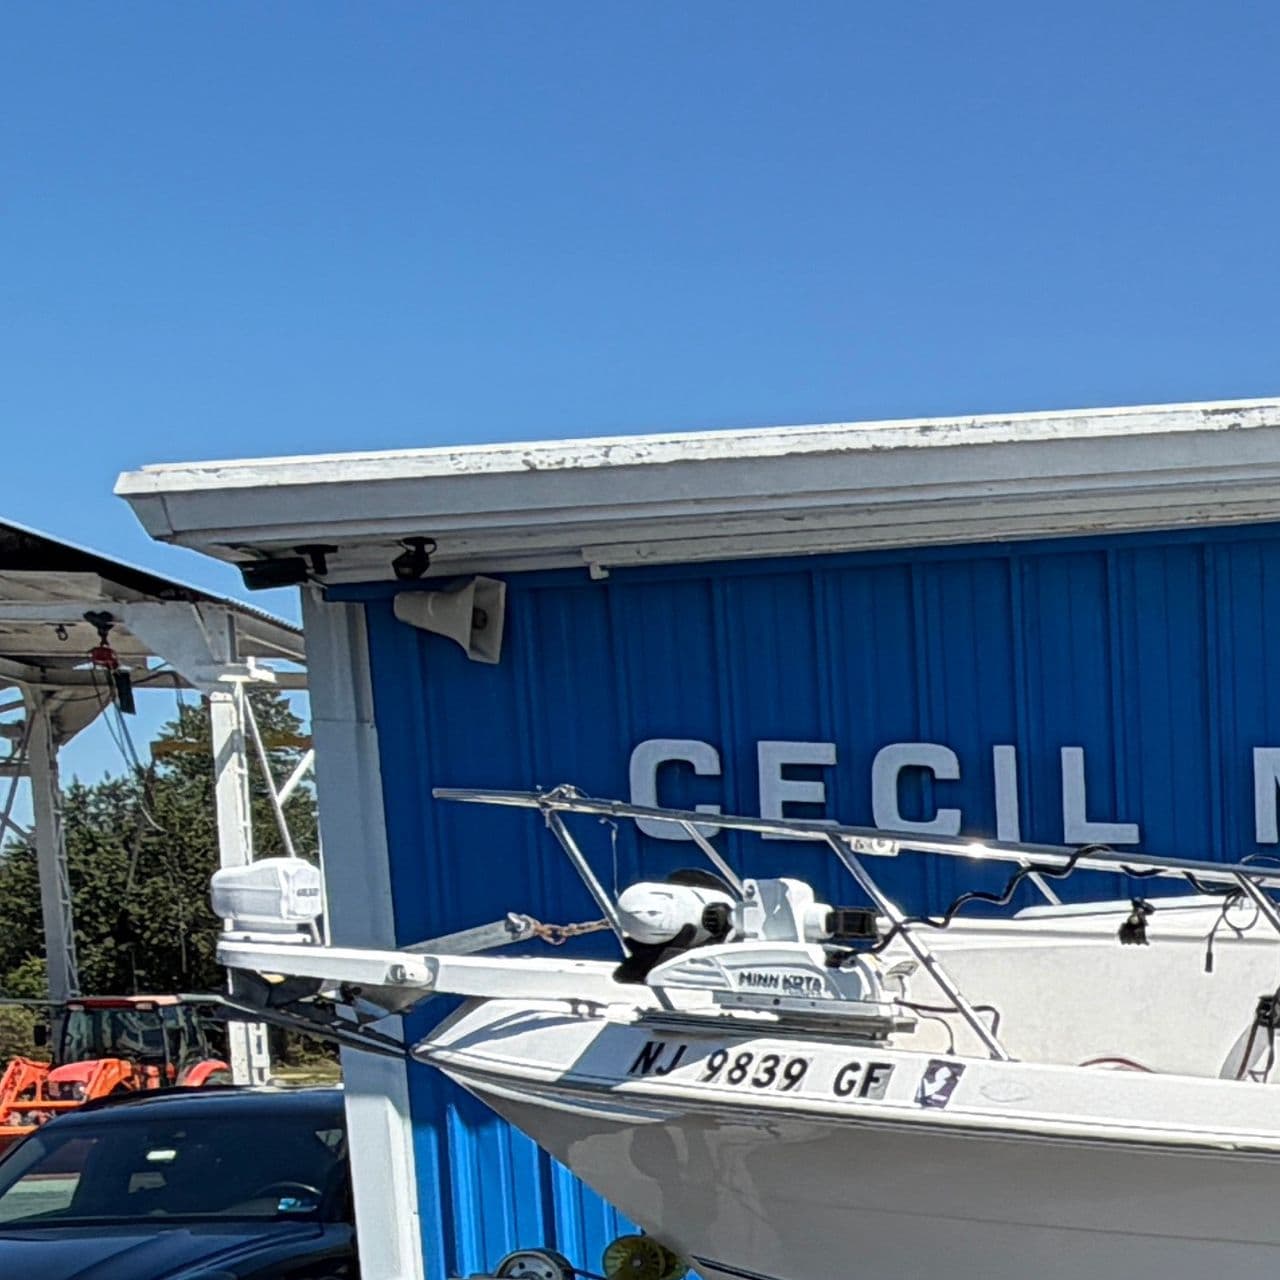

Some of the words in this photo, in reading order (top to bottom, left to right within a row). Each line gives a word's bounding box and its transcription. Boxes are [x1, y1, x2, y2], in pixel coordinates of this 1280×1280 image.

[629, 739, 1139, 844] CECIL
[738, 971, 780, 988] MINN
[627, 1041, 688, 1076] NJ
[700, 1049, 808, 1092] 9839
[833, 1062, 893, 1097] GF
